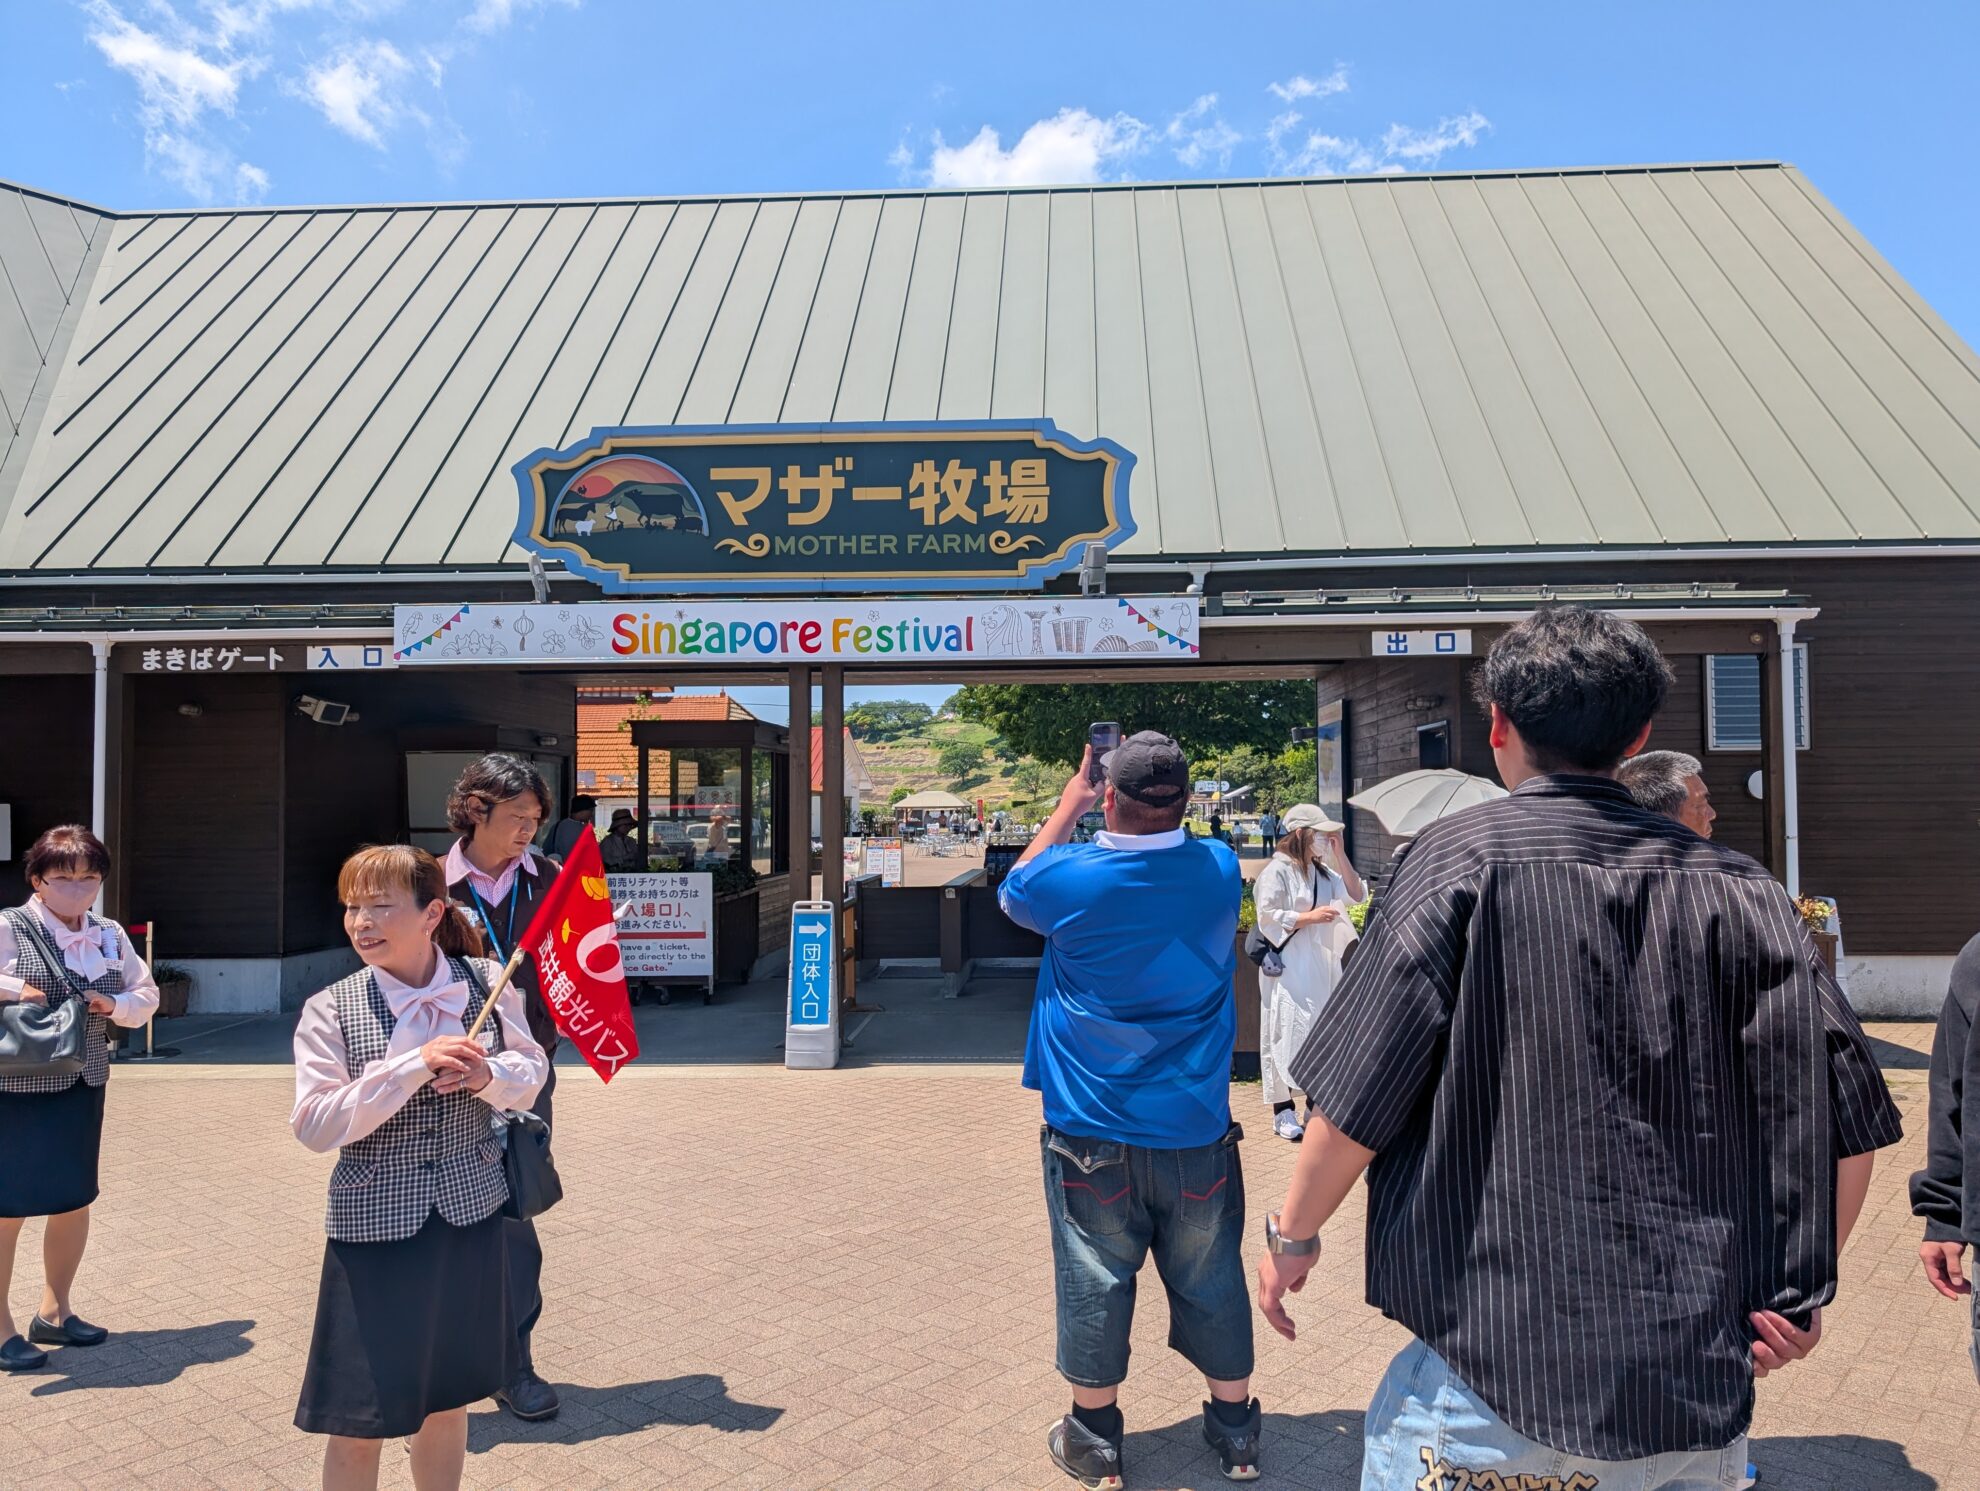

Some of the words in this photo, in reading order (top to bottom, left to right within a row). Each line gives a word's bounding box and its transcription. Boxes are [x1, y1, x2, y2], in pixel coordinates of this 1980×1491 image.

[709, 456, 1050, 526] マザー牧場
[774, 533, 898, 556] MOTHER
[907, 533, 986, 554] FARM
[611, 613, 822, 655] Singapore
[832, 617, 974, 653] Festival
[1387, 631, 1456, 654] 出口
[142, 647, 284, 671] まきばゲート
[318, 647, 382, 668] 入口
[607, 877, 689, 888] 前売りチケット等
[620, 943, 643, 951] have
[659, 943, 690, 951] ticket,
[624, 953, 636, 961] go
[638, 952, 675, 961] directly
[691, 952, 706, 960] the
[801, 943, 821, 1019] 団体入口
